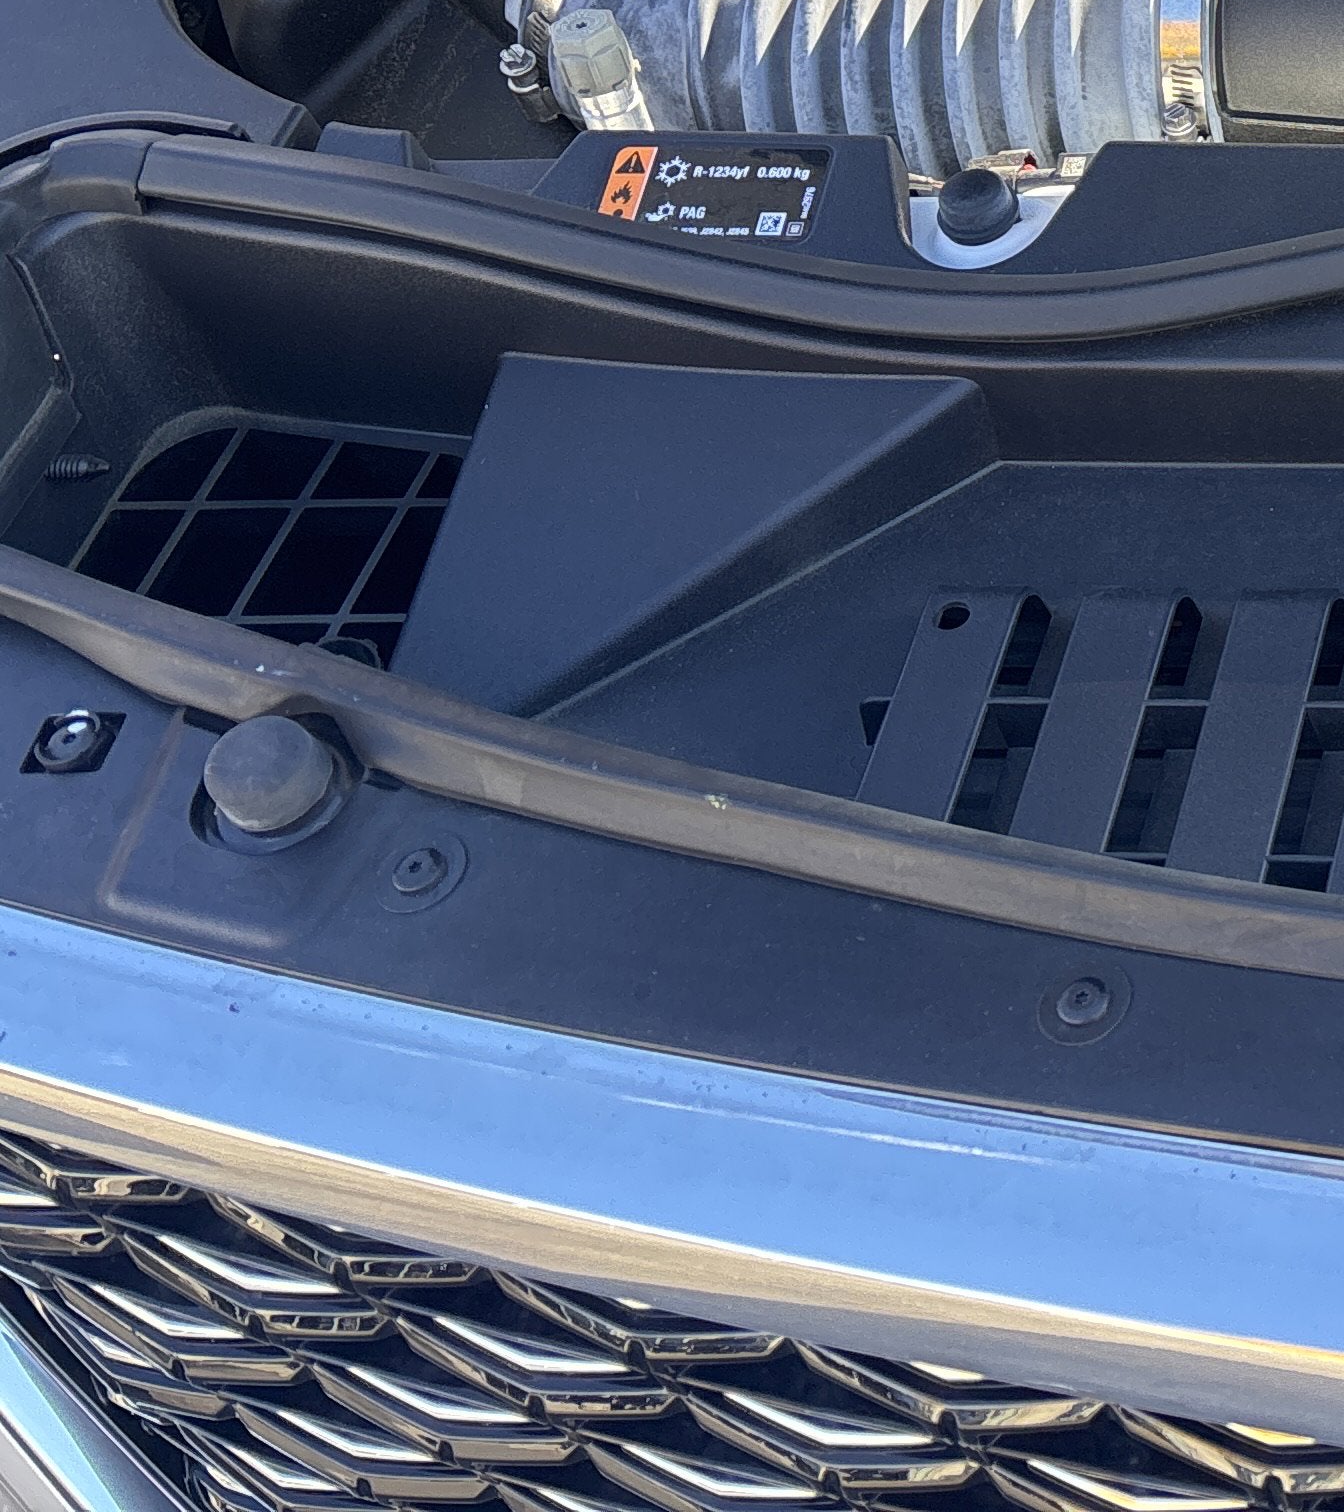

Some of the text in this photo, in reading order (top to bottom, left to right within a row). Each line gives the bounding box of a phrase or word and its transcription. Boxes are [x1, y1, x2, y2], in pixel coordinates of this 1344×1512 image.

[692, 164, 811, 182] R-1234yf 0.600 kg
[678, 205, 707, 219] PAG
